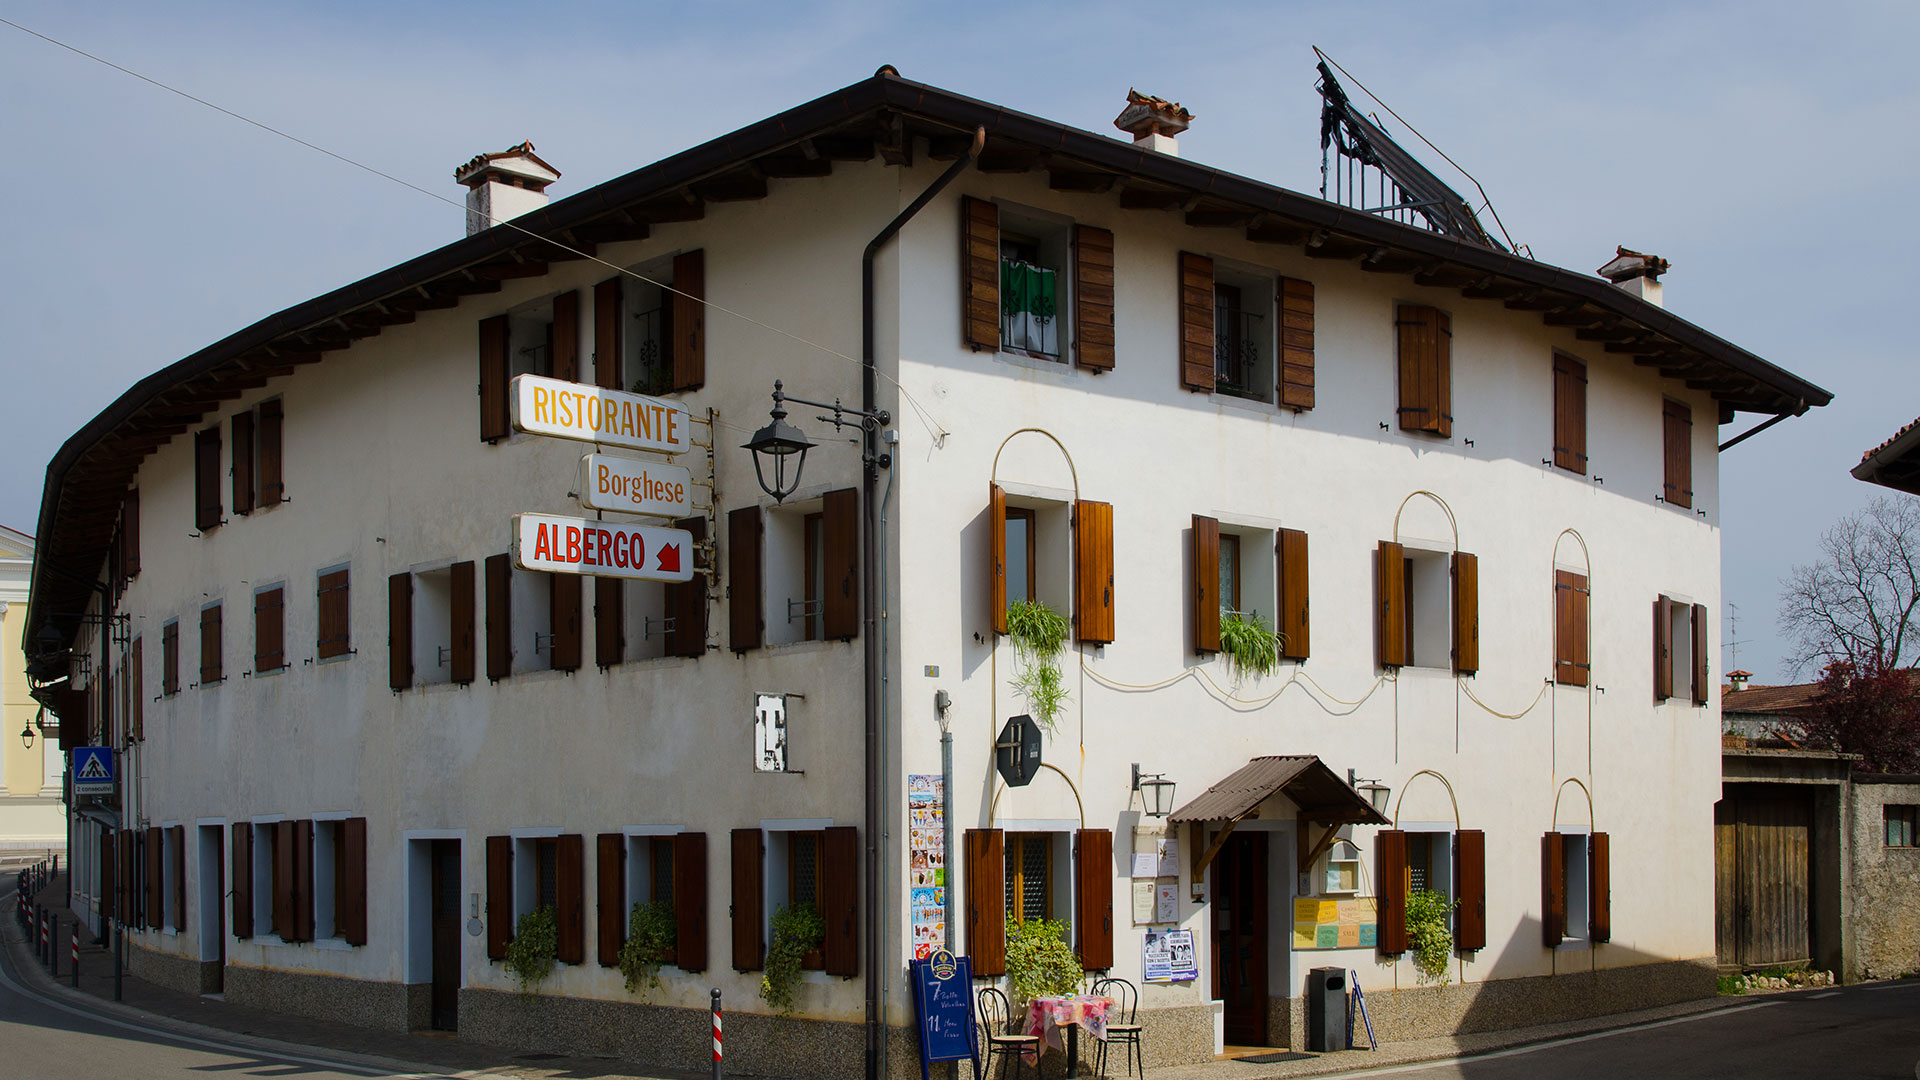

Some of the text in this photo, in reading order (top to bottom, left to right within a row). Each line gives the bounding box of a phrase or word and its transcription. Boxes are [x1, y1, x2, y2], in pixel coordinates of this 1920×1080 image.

[533, 386, 679, 444] RISTORANTE
[598, 464, 684, 503] Borghese
[534, 522, 646, 570] ALBERGO
